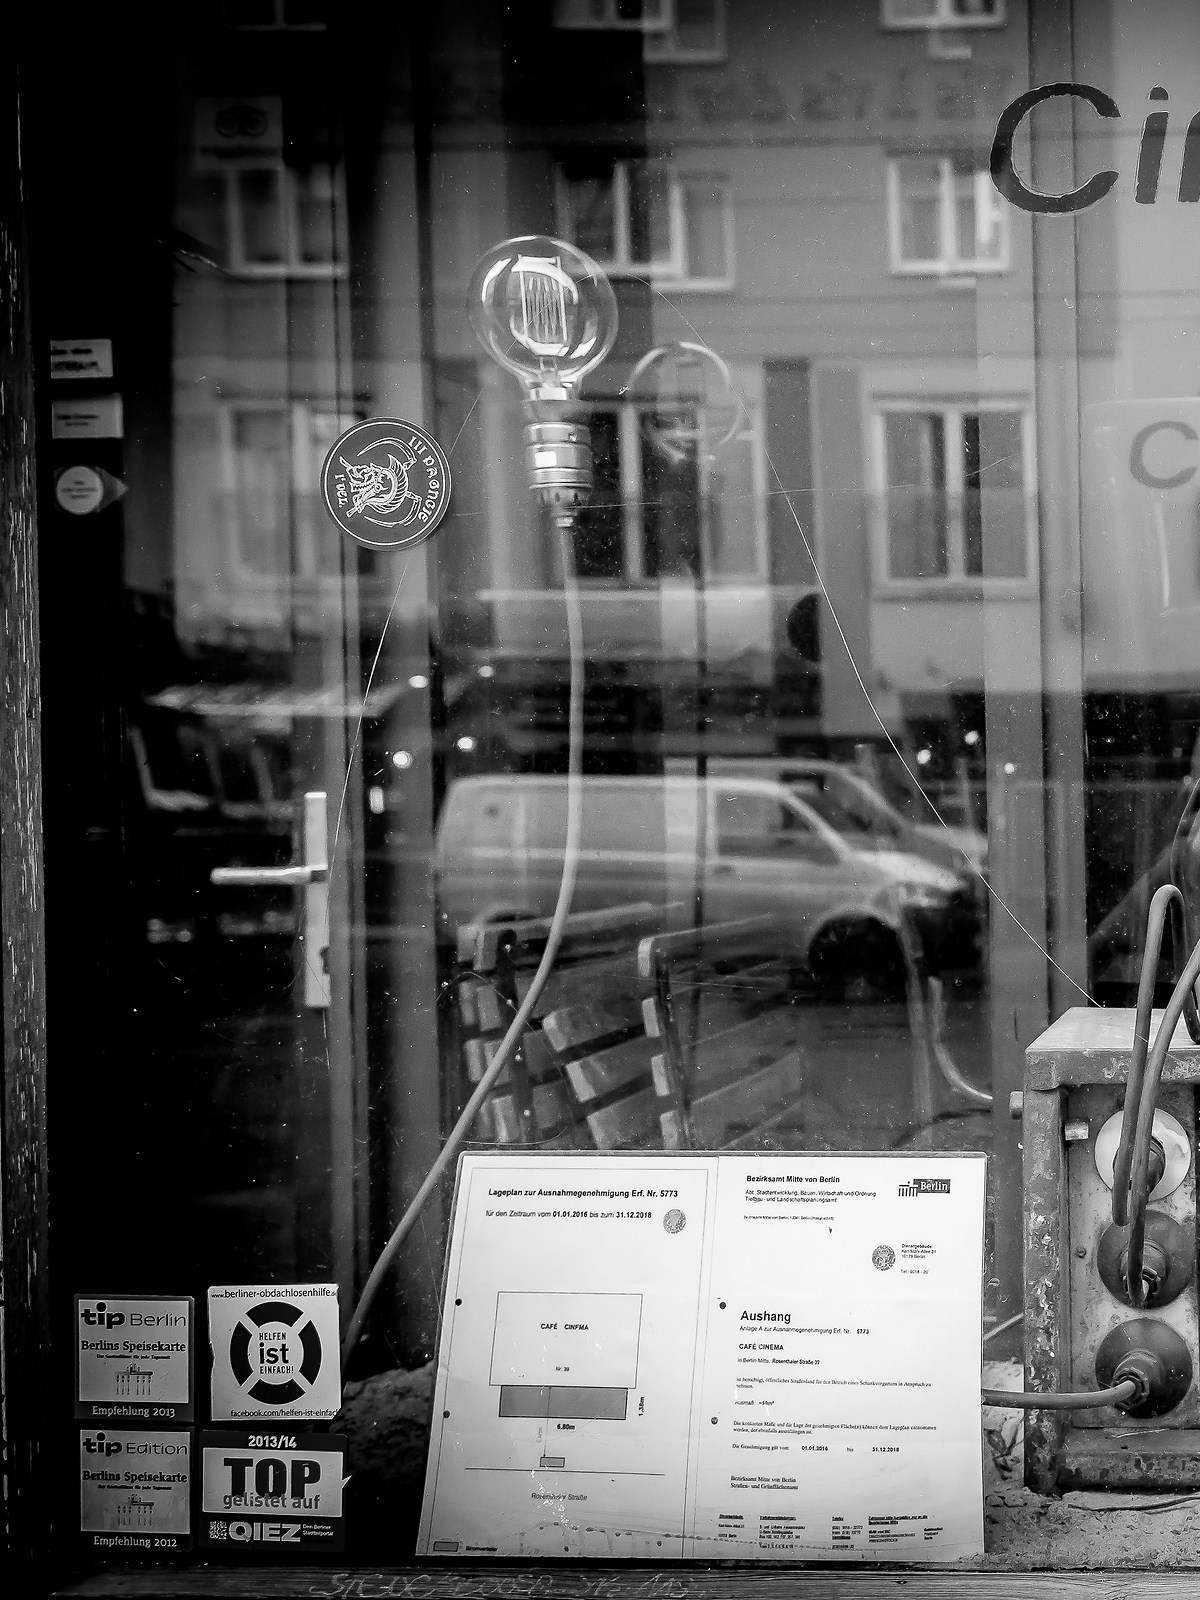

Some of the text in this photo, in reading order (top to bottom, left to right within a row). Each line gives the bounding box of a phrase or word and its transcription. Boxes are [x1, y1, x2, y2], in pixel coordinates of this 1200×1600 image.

[746, 1175, 785, 1183] Bezirksamt
[488, 1188, 522, 1198] Lageplan
[538, 1189, 629, 1198] Ausnahmegenehmigung
[920, 1181, 948, 1192] Berlin
[81, 1302, 186, 1330] tip Berlin
[740, 1310, 791, 1324] Aushang
[540, 1322, 558, 1330] CAFÉ
[259, 1332, 287, 1340] HELFEN
[81, 1340, 186, 1353] Berlins Speisekarte
[738, 1342, 757, 1350] CAFÉ
[259, 1342, 289, 1364] ist
[259, 1366, 294, 1374] EINFACH!
[92, 1406, 176, 1418] Empfehlung 2013
[83, 1432, 189, 1457] tip Edition
[248, 1435, 298, 1448] 2013/14
[82, 1470, 188, 1484] Berlins Speisekarte
[224, 1458, 321, 1500] TOP
[223, 1491, 321, 1510] gelistet auf
[228, 1521, 301, 1542] QIEZ
[93, 1536, 177, 1548] Empfehlung 2012
